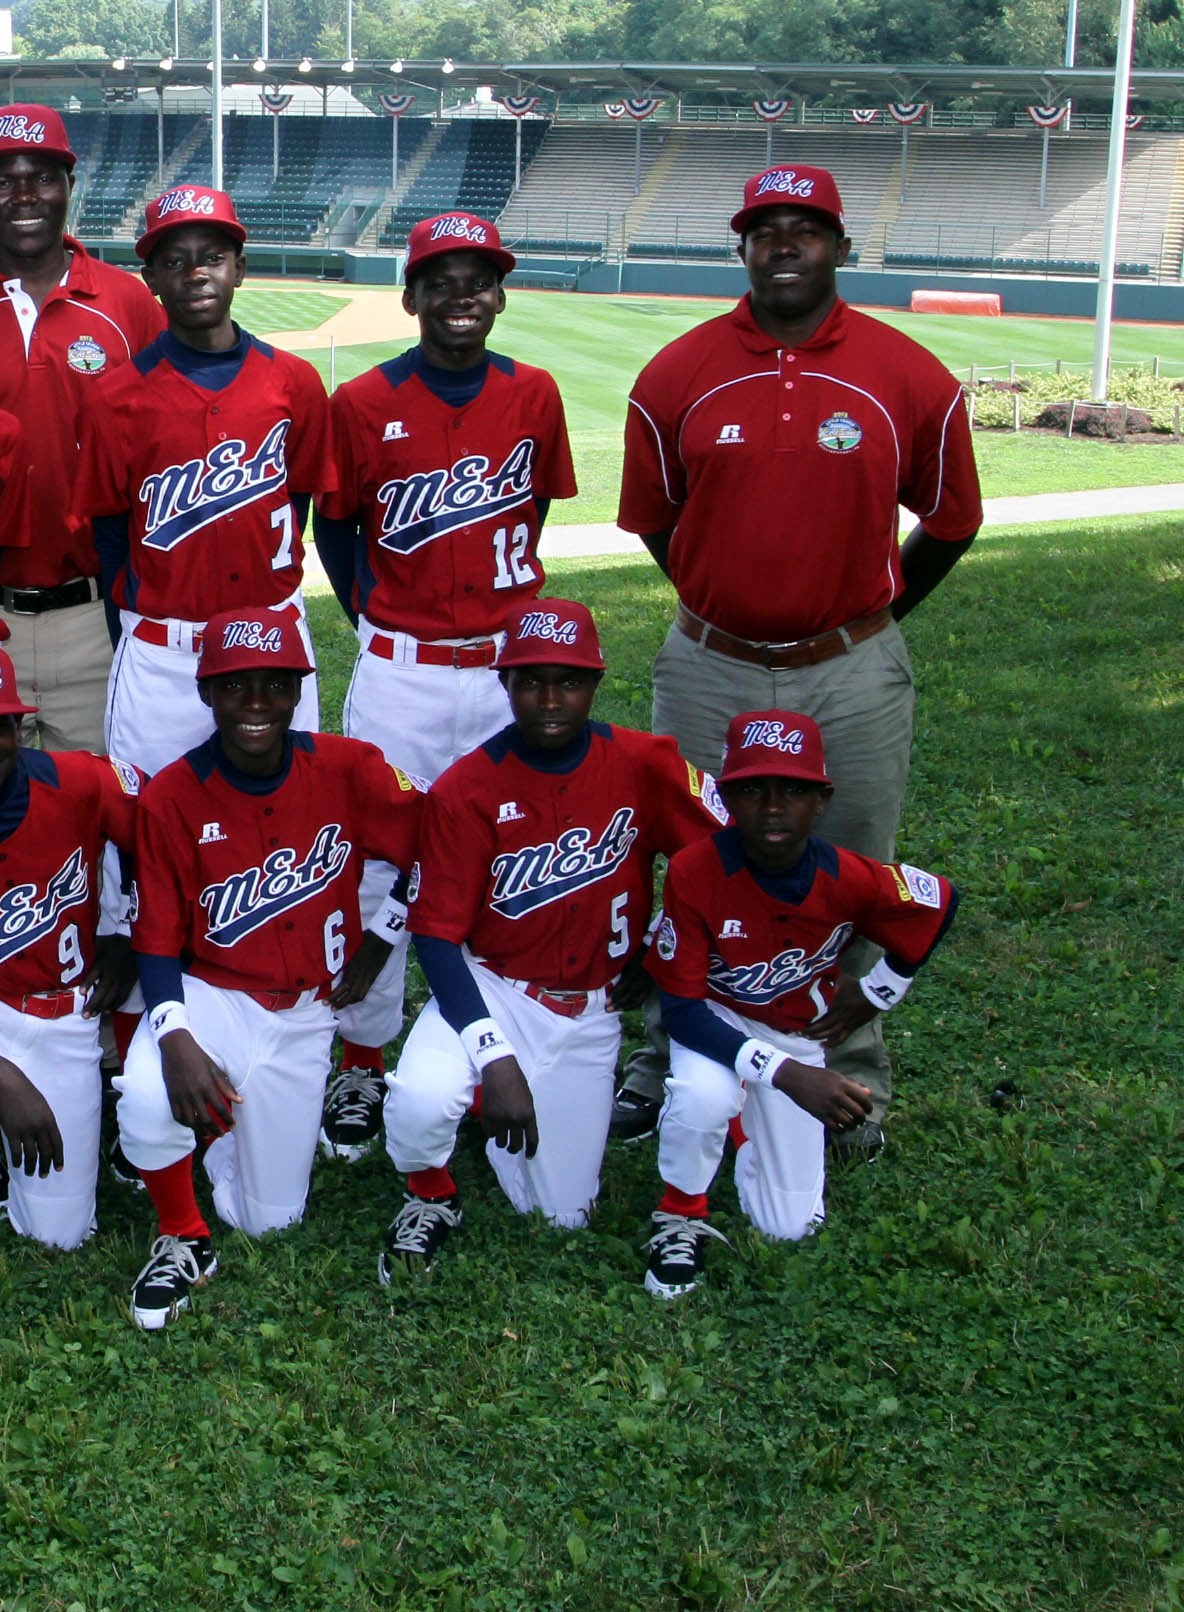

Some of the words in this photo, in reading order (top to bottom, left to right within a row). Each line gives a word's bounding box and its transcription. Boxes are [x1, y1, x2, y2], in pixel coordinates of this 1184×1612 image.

[755, 170, 814, 198] MEA
[158, 190, 214, 218] MEA
[430, 217, 486, 244] MEA
[384, 421, 403, 436] R
[719, 424, 741, 439] R
[139, 419, 291, 531] MEA
[377, 439, 533, 532] MEA
[270, 503, 293, 571] 7
[493, 523, 536, 589] 12
[222, 621, 282, 653] MEA
[516, 611, 578, 646] MEA
[740, 719, 804, 755] MEA
[499, 802, 517, 818] R
[202, 822, 220, 838] R
[492, 807, 635, 899] MEA
[199, 823, 346, 931] MEA
[608, 892, 629, 958] 5
[723, 919, 742, 934] R
[58, 923, 84, 984] 9
[324, 909, 346, 975] 6
[479, 1032, 495, 1049] R
[750, 1050, 766, 1070] R
